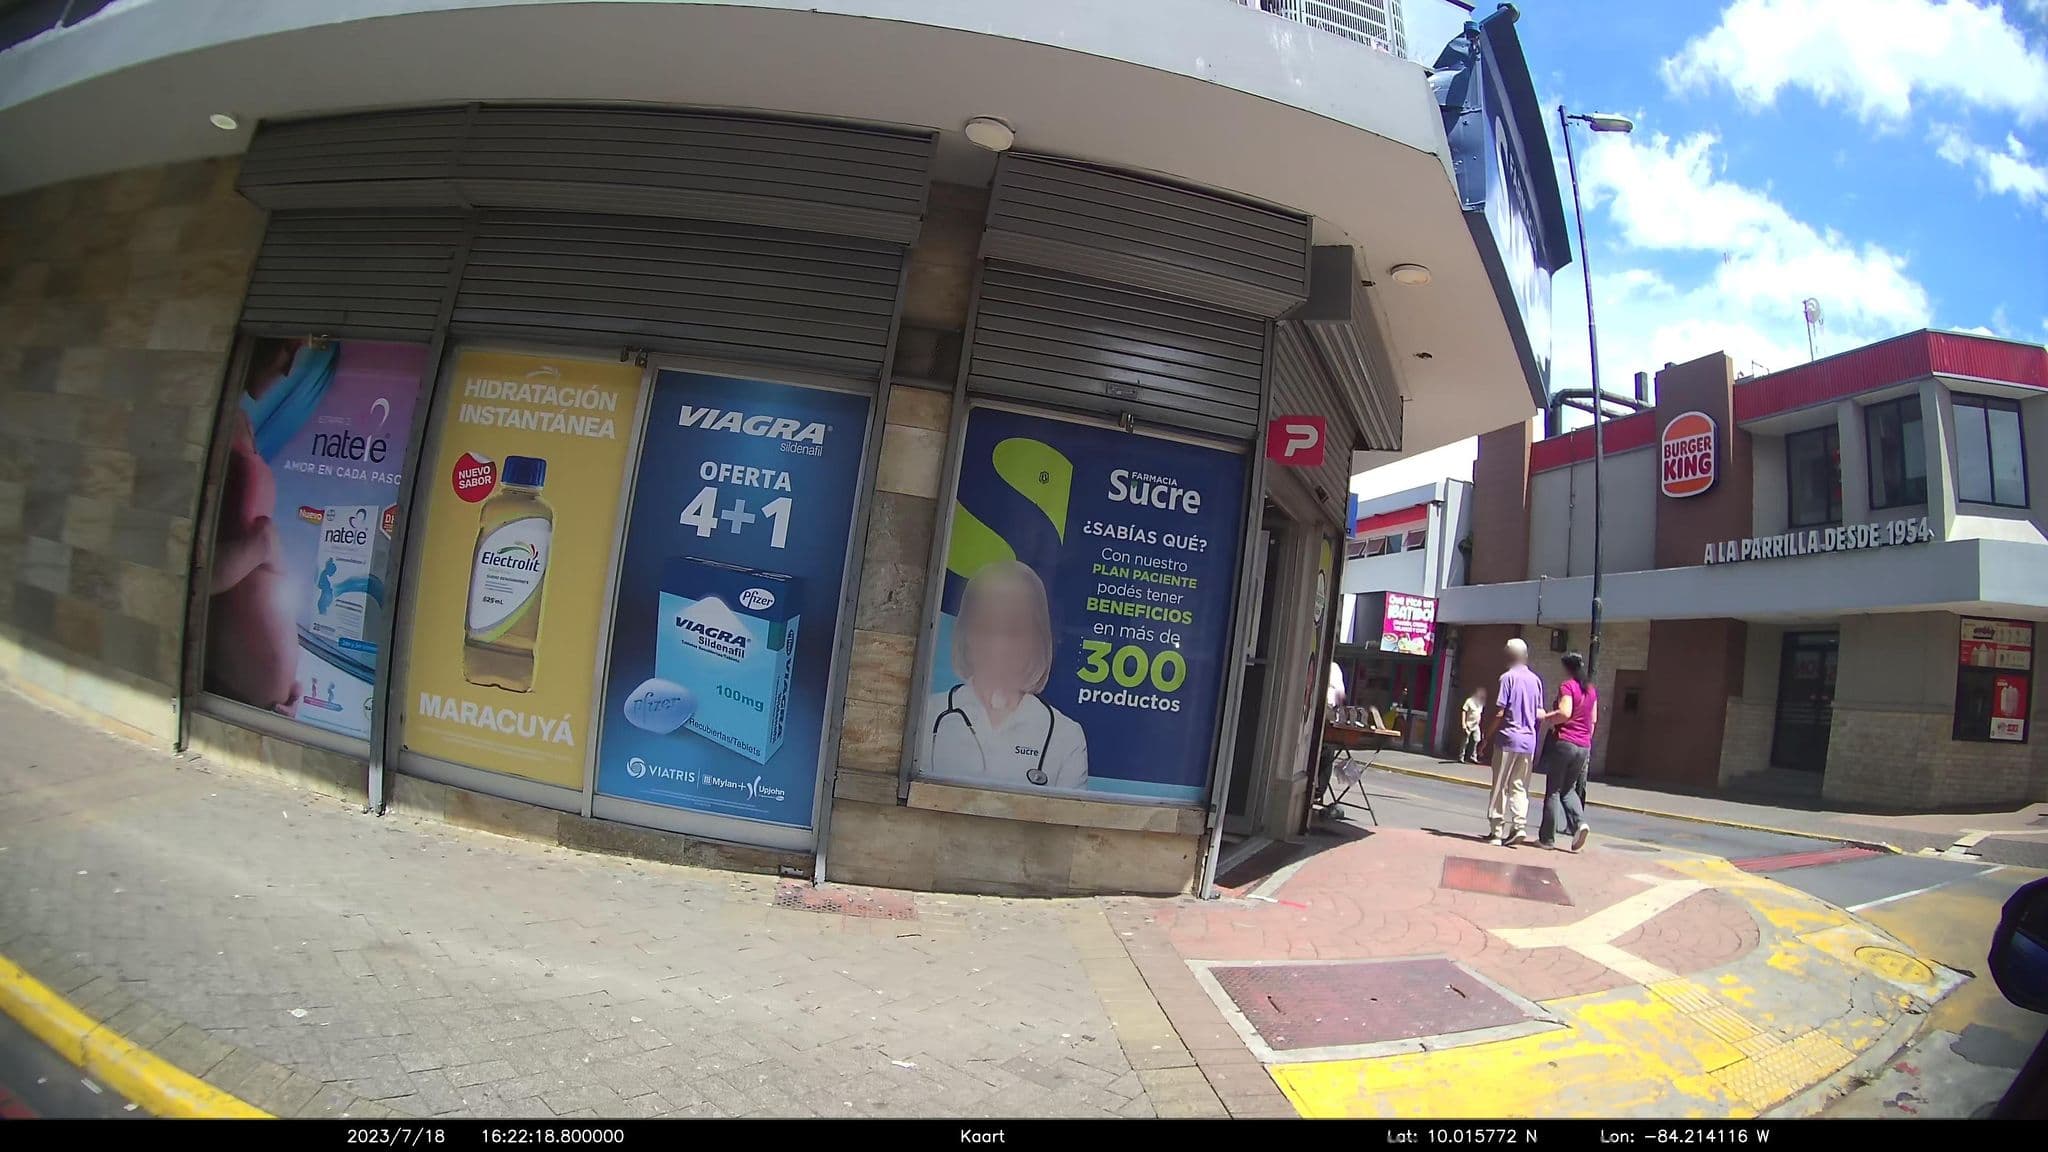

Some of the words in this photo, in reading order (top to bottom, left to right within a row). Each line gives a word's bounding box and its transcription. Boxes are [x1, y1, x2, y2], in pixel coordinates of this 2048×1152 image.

[463, 378, 618, 412] HIDRATACIÓN
[459, 403, 616, 439] INSTANTÁNEA
[678, 405, 826, 445] VIAGRA
[312, 430, 387, 463] natele
[780, 442, 823, 457] sildenafil
[1664, 435, 1712, 460] BURGER
[284, 460, 315, 473] AMOR
[318, 464, 332, 476] EN
[336, 466, 367, 480] CADA
[458, 465, 491, 480] NUEVO
[700, 461, 792, 492] OFERTA
[1131, 471, 1178, 487] FARMACIA
[1664, 452, 1712, 481] KING
[458, 475, 492, 490] SABOR
[1108, 469, 1201, 514] Sucre
[679, 486, 793, 549] 4+1
[325, 527, 367, 545] natele
[1083, 520, 1158, 545] ¿SABÍAS
[1163, 533, 1208, 552] QUÉ?
[1704, 543, 1716, 564] A
[1718, 540, 1738, 563] LA
[1741, 530, 1820, 561] PARRILLA
[1825, 523, 1881, 552] DESDE
[1887, 516, 1930, 546] 1954
[481, 551, 541, 573] Electrolit
[1101, 547, 1130, 563] Con
[1134, 555, 1188, 572] nuestro
[1092, 563, 1129, 578] PLAN
[1132, 570, 1199, 589] PACIENTE
[742, 590, 773, 609] Pfizer
[1097, 582, 1142, 599] podés
[1146, 587, 1184, 604] tener
[1086, 596, 1193, 624] BENEFICIOS
[675, 616, 747, 648] VIAGRA
[1093, 622, 1114, 636] en
[1119, 625, 1154, 642] más
[1159, 629, 1181, 645] de
[698, 636, 745, 658] Sildenafil
[1076, 639, 1187, 693] 300
[716, 684, 764, 712] 100mg
[1078, 687, 1181, 713] productos
[418, 692, 575, 747] MARACUYÁ
[1015, 745, 1039, 757] Sucre
[649, 765, 696, 783] VIATRIS
[759, 785, 785, 796] Upjohn
